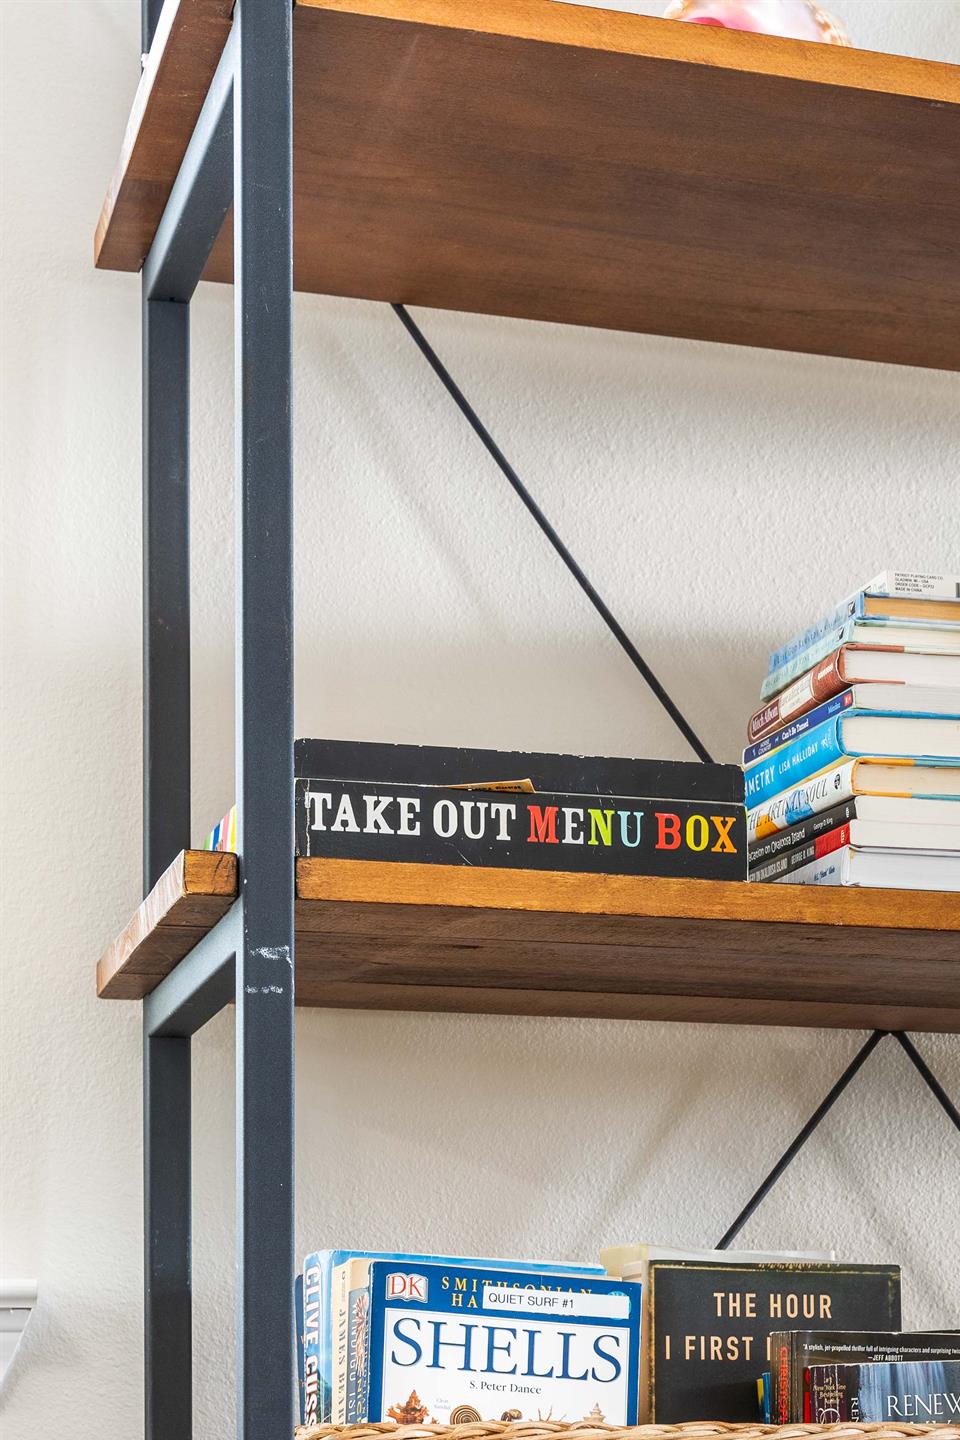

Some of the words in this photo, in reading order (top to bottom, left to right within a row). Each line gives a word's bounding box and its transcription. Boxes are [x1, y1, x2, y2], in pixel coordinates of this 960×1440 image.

[752, 713, 765, 732] Mitch
[781, 728, 791, 741] Can't
[797, 719, 809, 733] Tamed
[779, 760, 791, 775] LISA
[792, 742, 819, 768] HALLIDAY
[748, 808, 763, 831] THE
[804, 778, 828, 803] SOUL
[306, 791, 421, 836] TAKE
[433, 799, 517, 841] OUT
[527, 805, 644, 848] MENU
[654, 812, 738, 853] BOX
[791, 828, 806, 846] Island
[391, 1276, 425, 1298] DK
[488, 1292, 524, 1305] QUIET
[527, 1296, 558, 1308] SURF
[562, 1299, 574, 1308] #1
[305, 1266, 321, 1345] CLIVE
[713, 1292, 757, 1318] THE
[769, 1293, 832, 1319] HOUR
[338, 1309, 347, 1366] JAMES
[391, 1317, 622, 1383] SHELLS
[665, 1335, 671, 1360] I
[685, 1335, 753, 1361] FIRST
[808, 1344, 824, 1352] stylish,
[824, 1344, 851, 1352] jet-propelled
[879, 1346, 899, 1354] intriguing
[930, 1347, 951, 1355] surprising
[469, 1380, 478, 1389] S.
[481, 1381, 507, 1393] Peter
[510, 1384, 542, 1395] Dance
